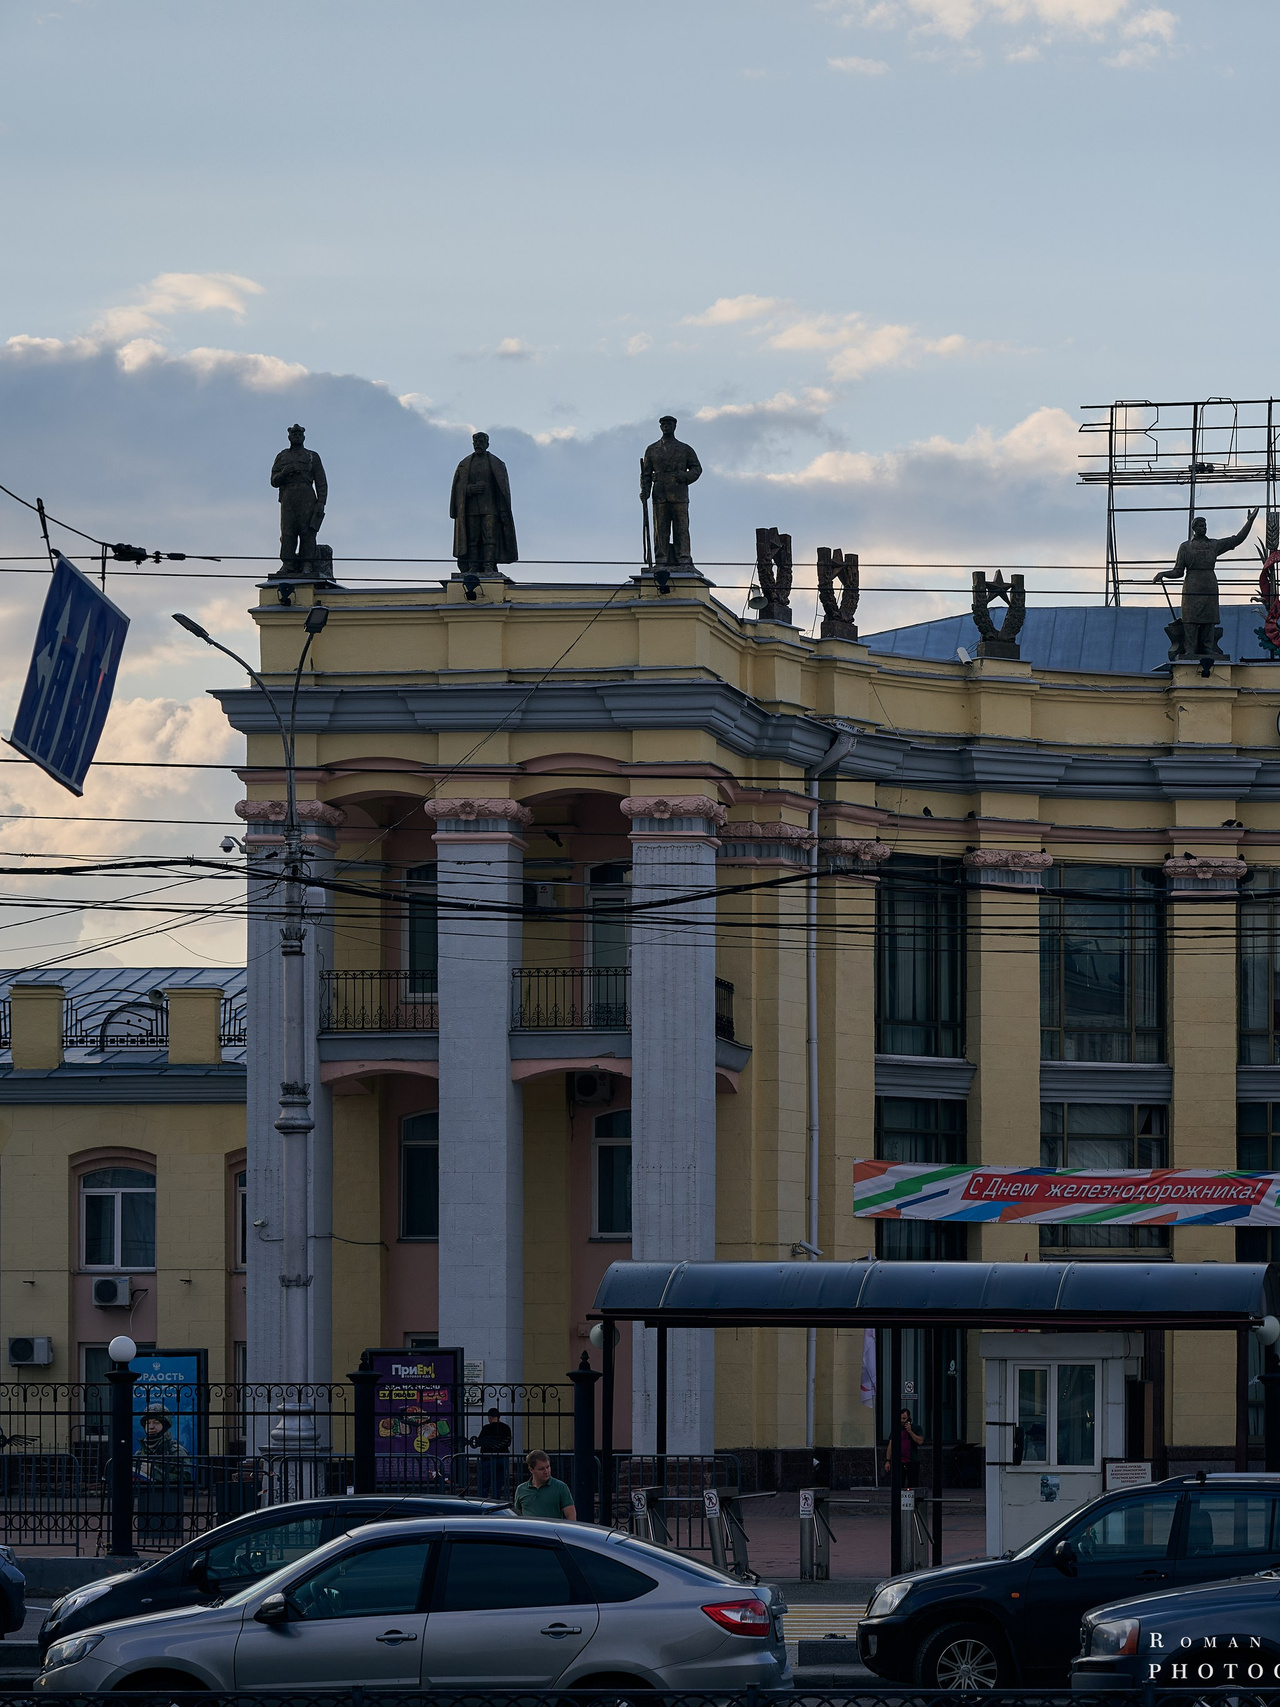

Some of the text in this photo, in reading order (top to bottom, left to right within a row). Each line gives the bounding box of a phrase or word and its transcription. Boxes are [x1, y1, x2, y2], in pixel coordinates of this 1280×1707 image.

[969, 1177, 1262, 1202] С Днем железнодорожника!
[391, 1362, 436, 1379] ПриЕм!
